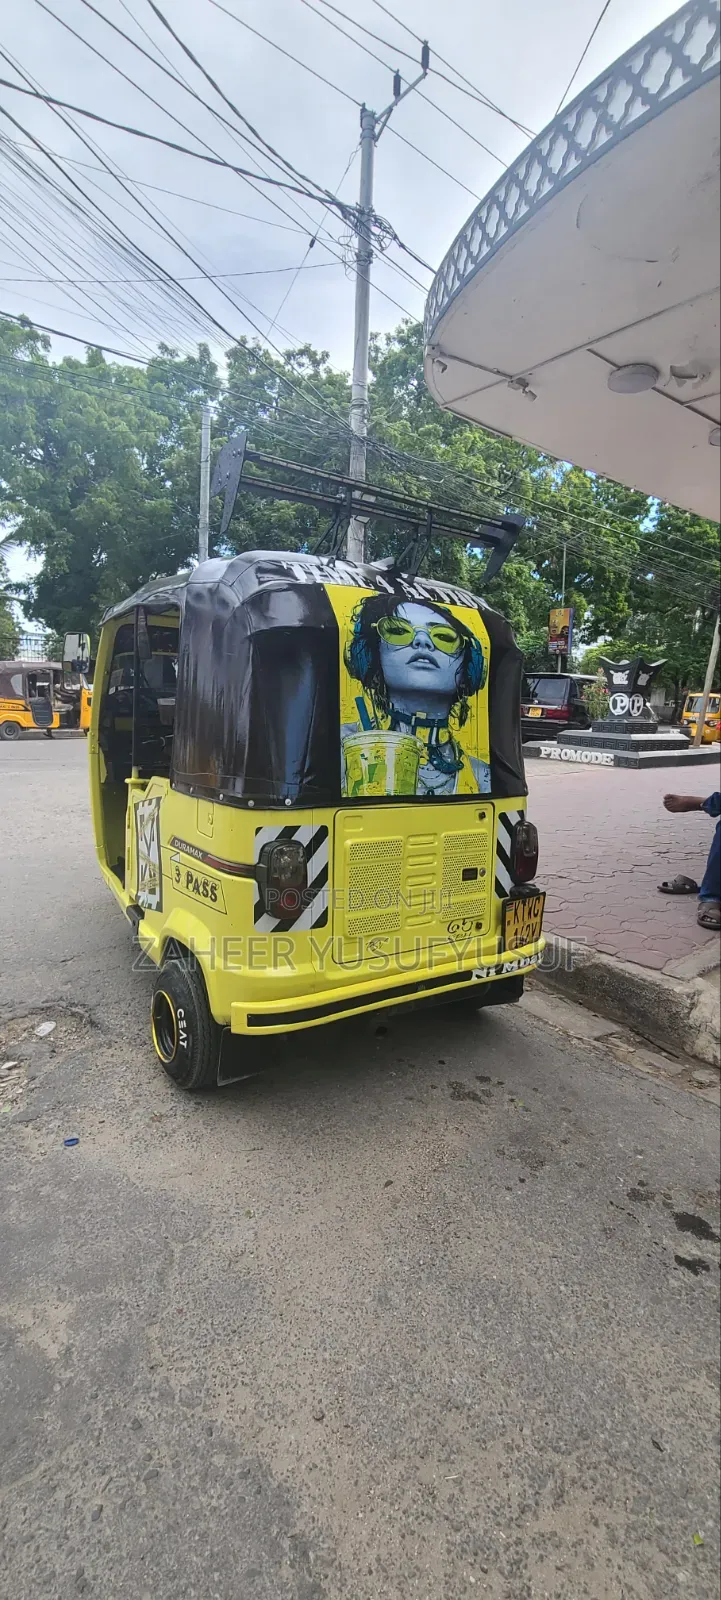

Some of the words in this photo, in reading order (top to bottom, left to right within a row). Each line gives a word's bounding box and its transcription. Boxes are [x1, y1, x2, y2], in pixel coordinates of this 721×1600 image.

[375, 574, 395, 595] 4
[539, 746, 615, 767] PROMODE
[174, 839, 203, 860] DURAMAX
[174, 865, 181, 884] 3
[186, 870, 218, 902] PASS
[177, 1008, 188, 1048] CEAT
